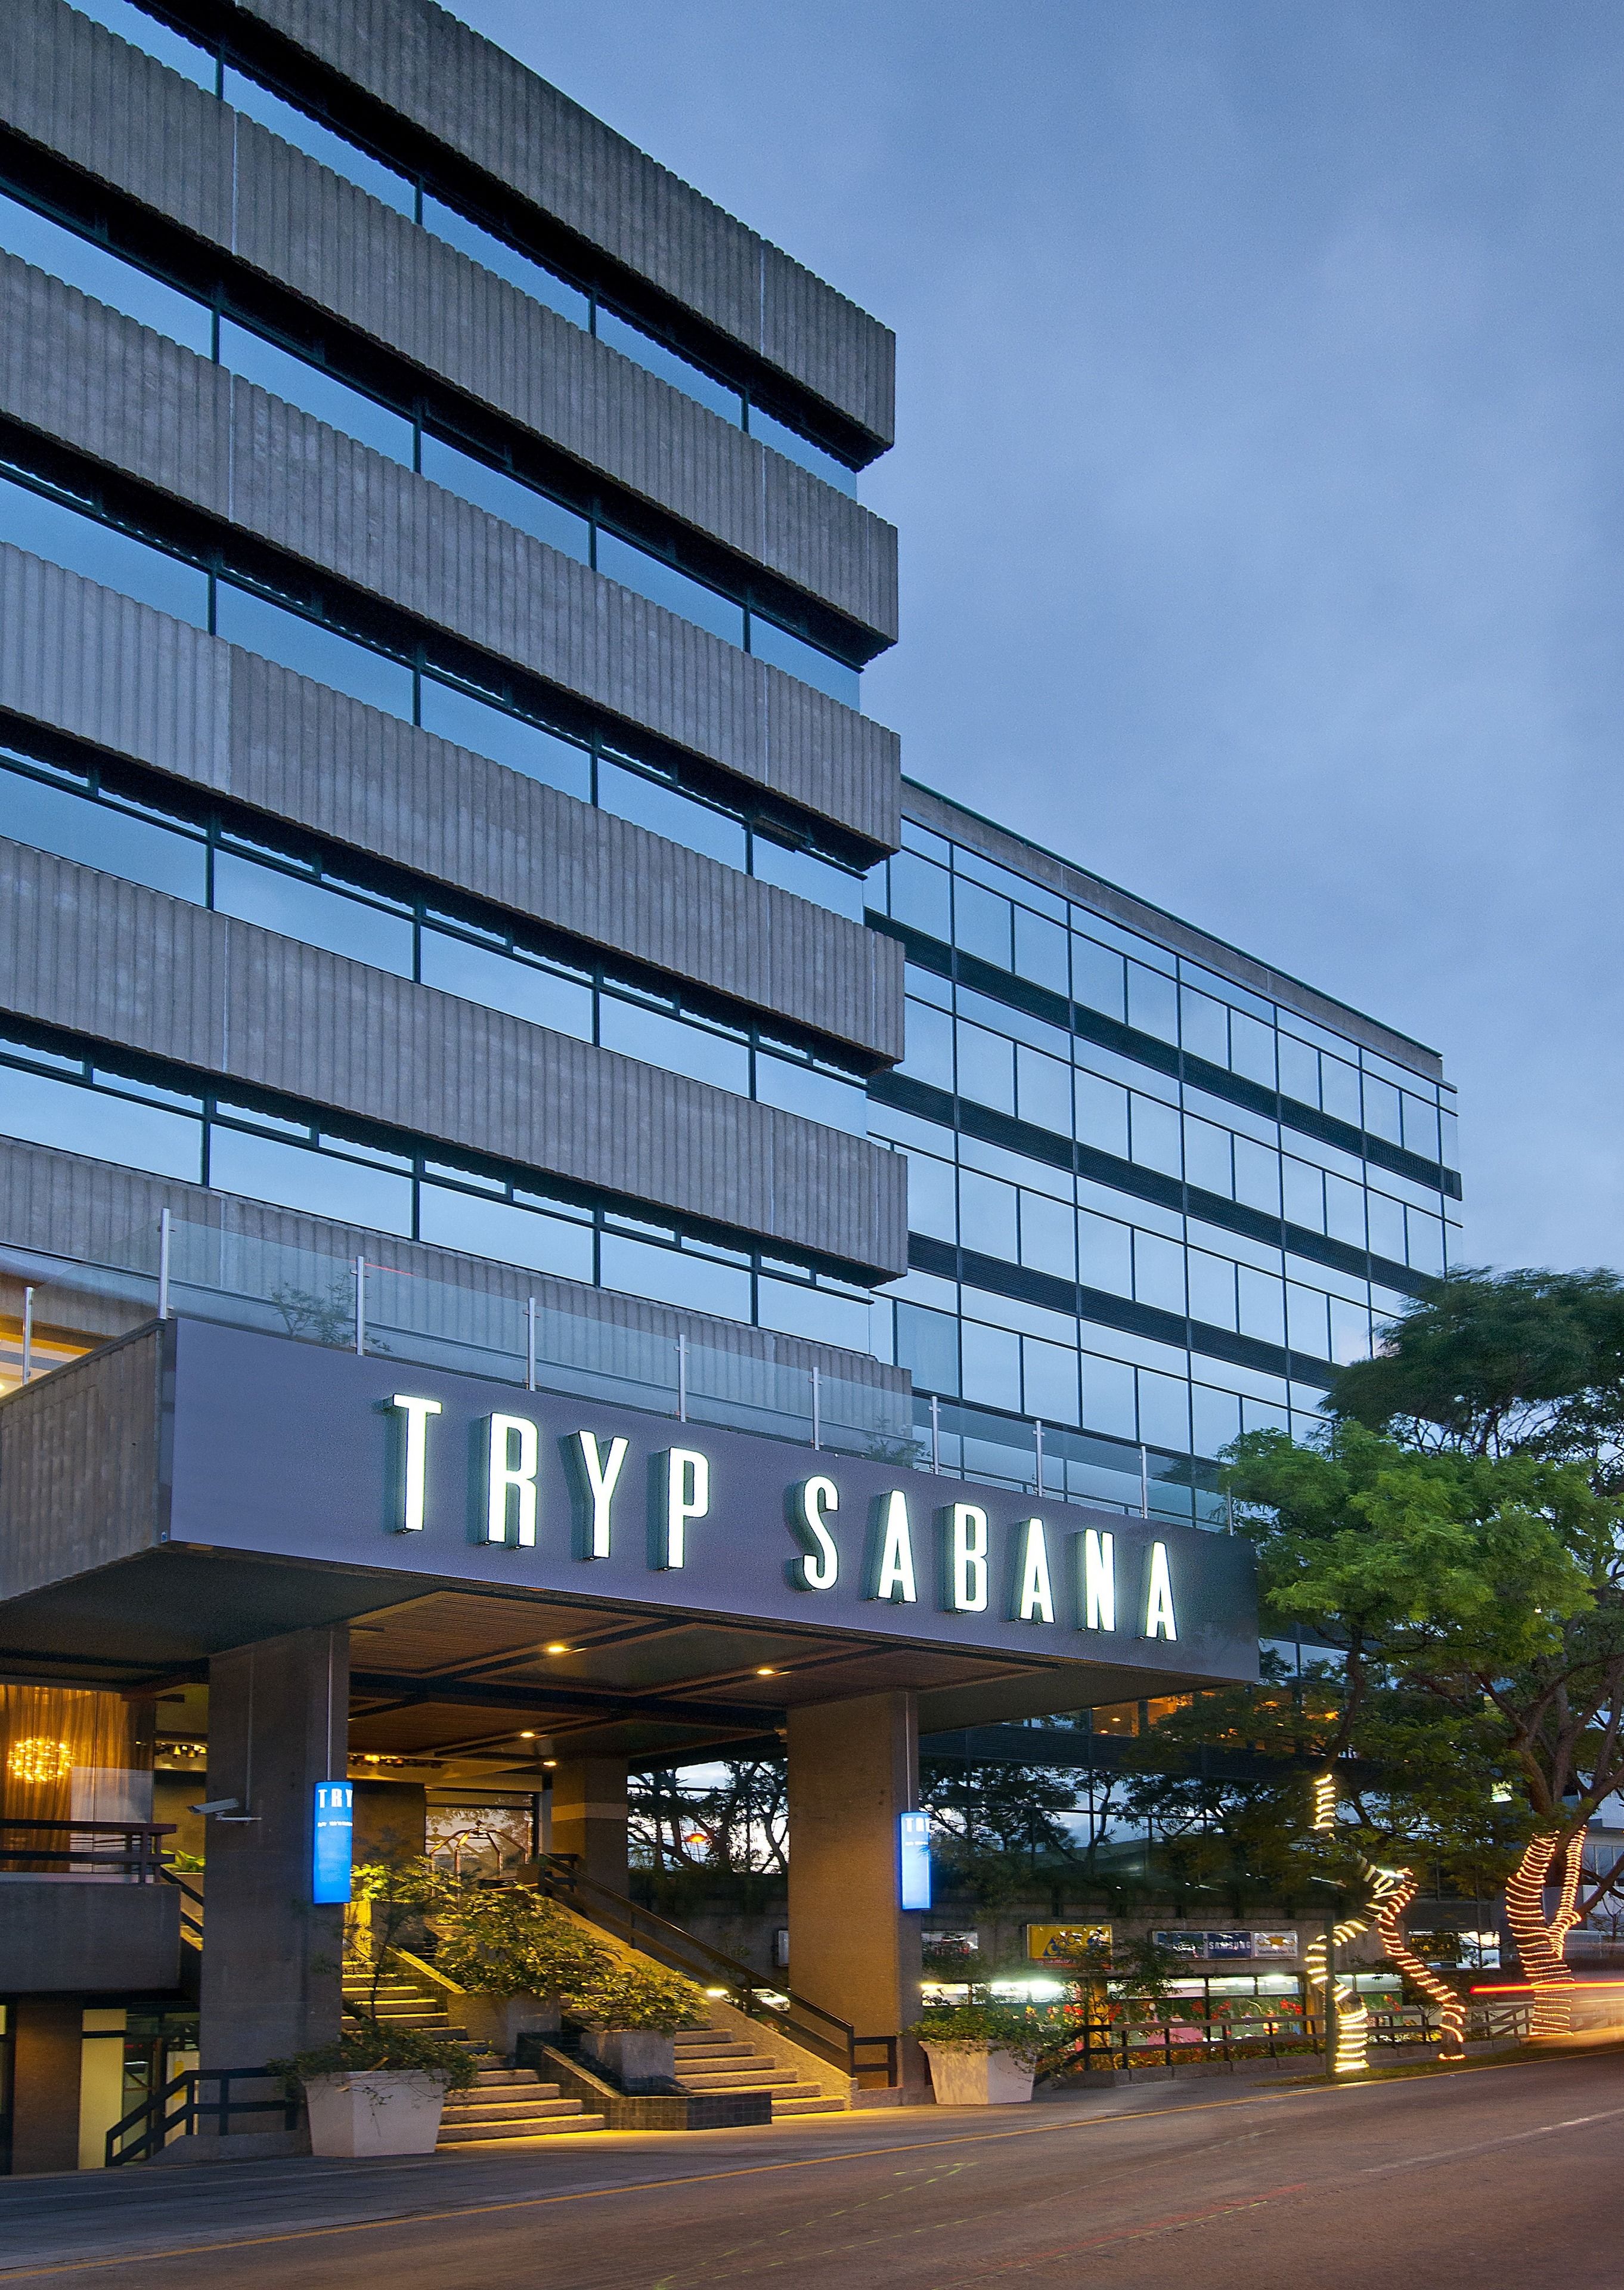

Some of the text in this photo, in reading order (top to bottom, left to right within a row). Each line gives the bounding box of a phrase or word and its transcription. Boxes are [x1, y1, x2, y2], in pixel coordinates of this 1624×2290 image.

[392, 1393, 1177, 1642] TRYP SABANA
[1208, 1941, 1251, 1949] SAMSUNG
